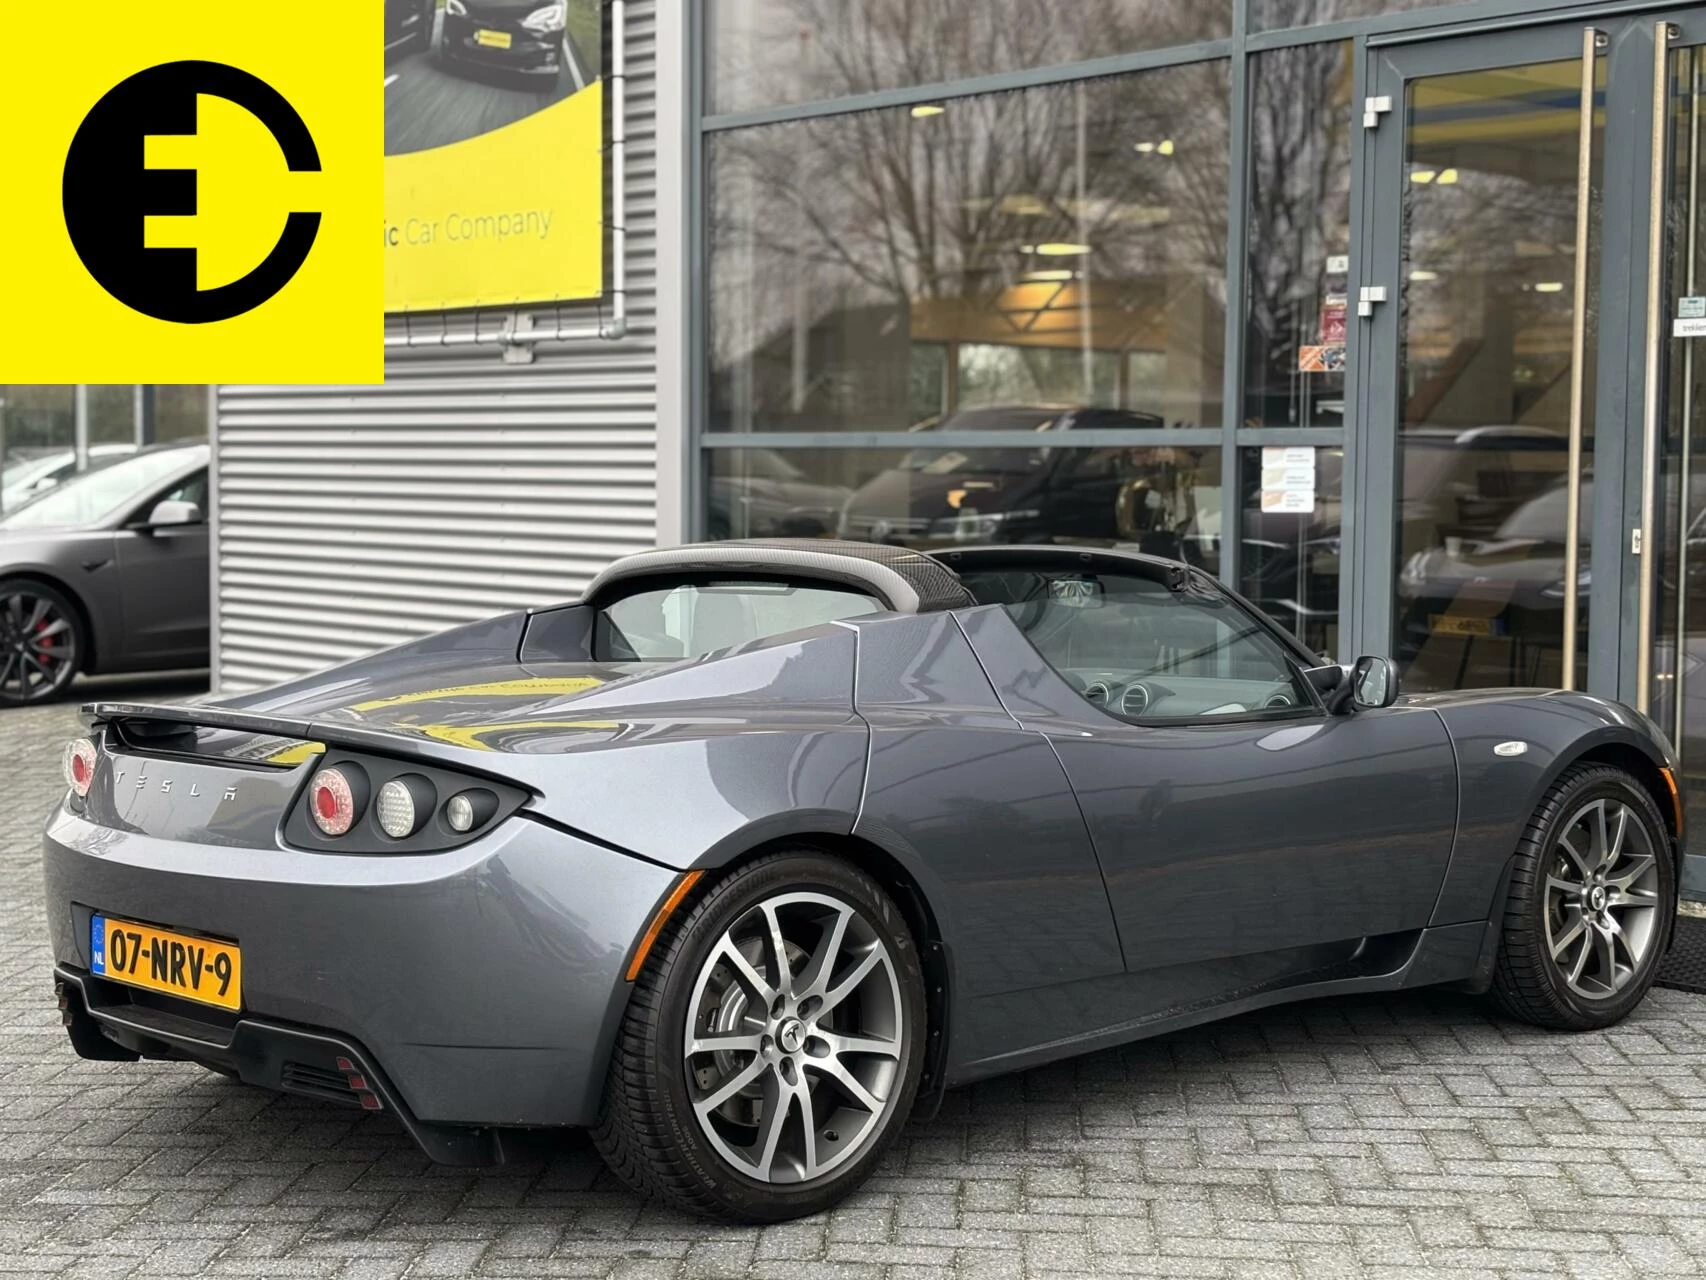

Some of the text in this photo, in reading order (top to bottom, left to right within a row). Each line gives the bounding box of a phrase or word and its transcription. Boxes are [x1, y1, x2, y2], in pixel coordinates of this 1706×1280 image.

[405, 218, 438, 245] Car
[445, 209, 553, 241] Company
[116, 771, 237, 801] TESLA
[94, 951, 105, 965] NL
[110, 929, 232, 996] 07-NRV-9
